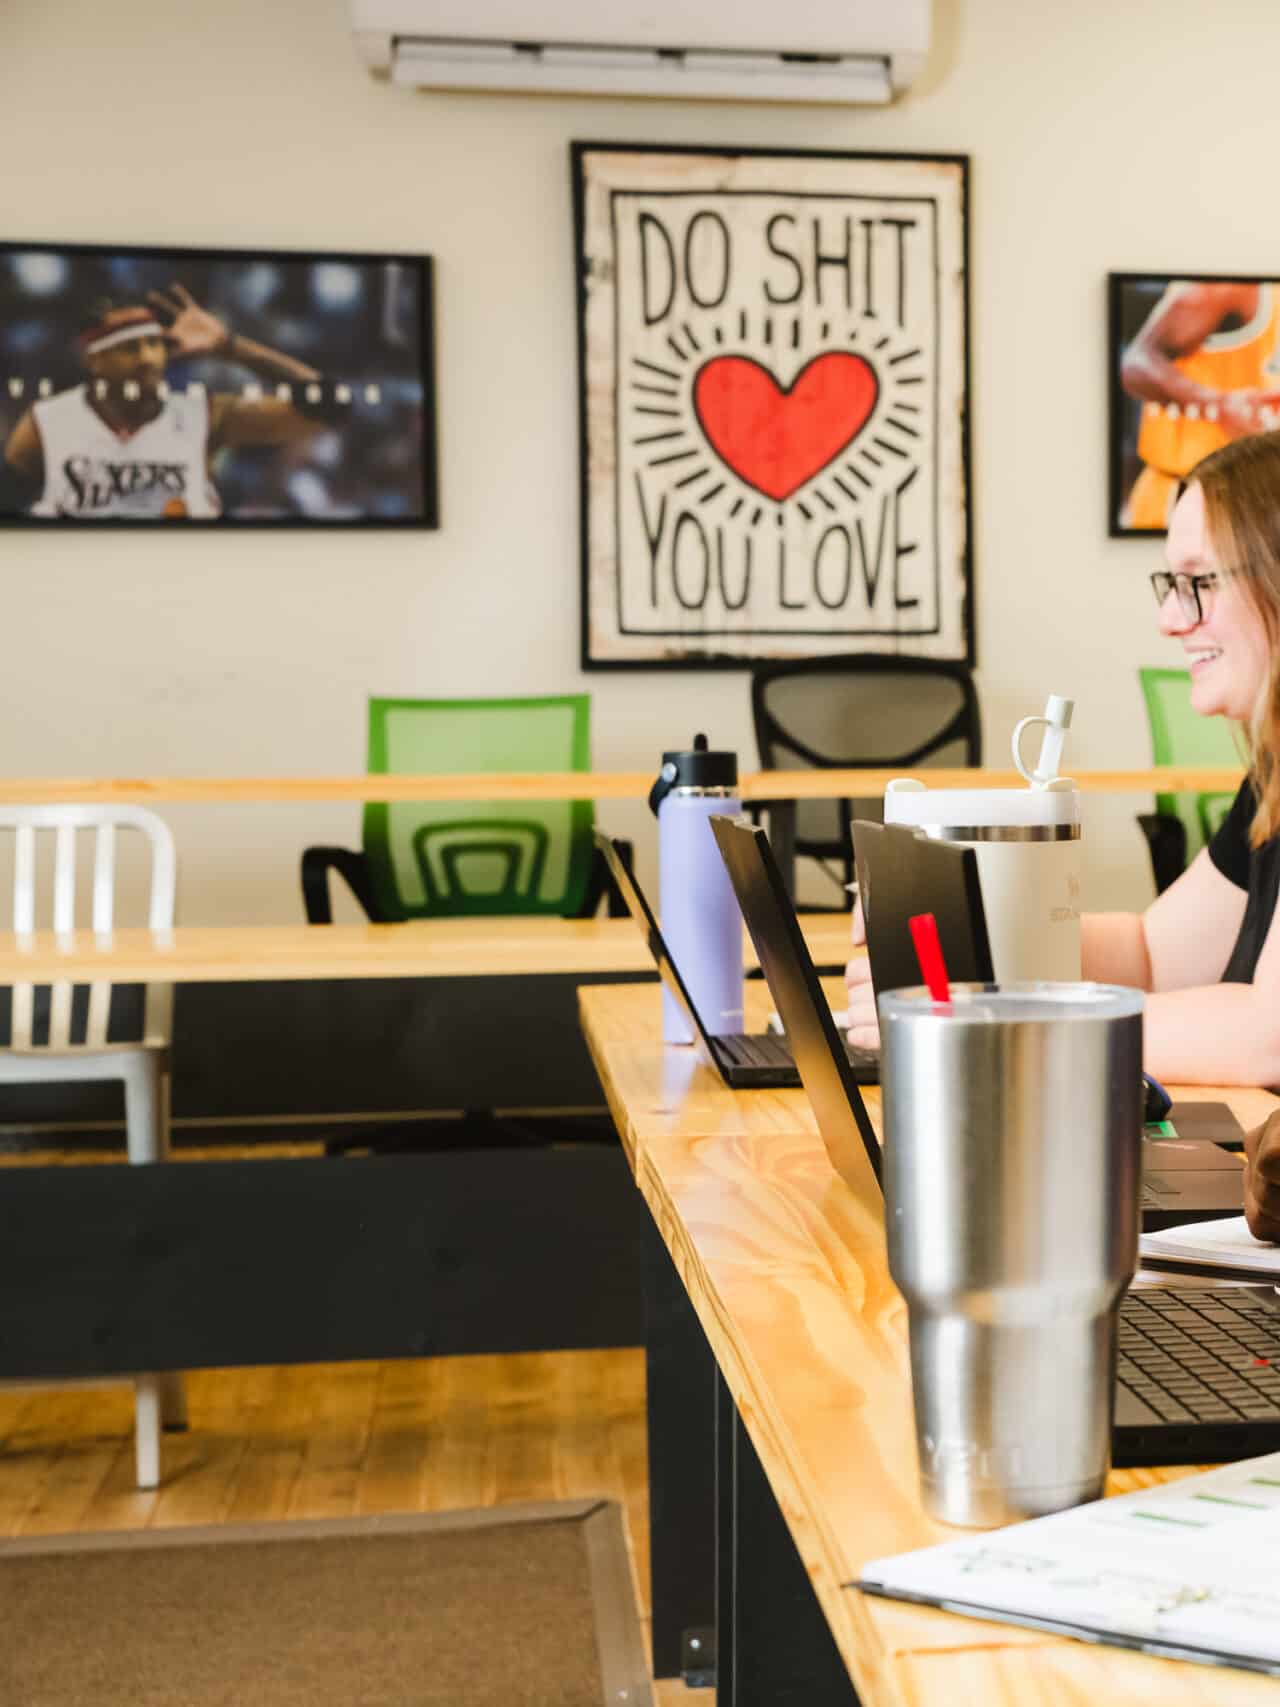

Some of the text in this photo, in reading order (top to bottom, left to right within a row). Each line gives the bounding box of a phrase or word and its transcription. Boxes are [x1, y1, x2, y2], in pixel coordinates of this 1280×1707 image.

[639, 211, 917, 329] DO SHIT
[635, 466, 918, 609] YOU LOVE
